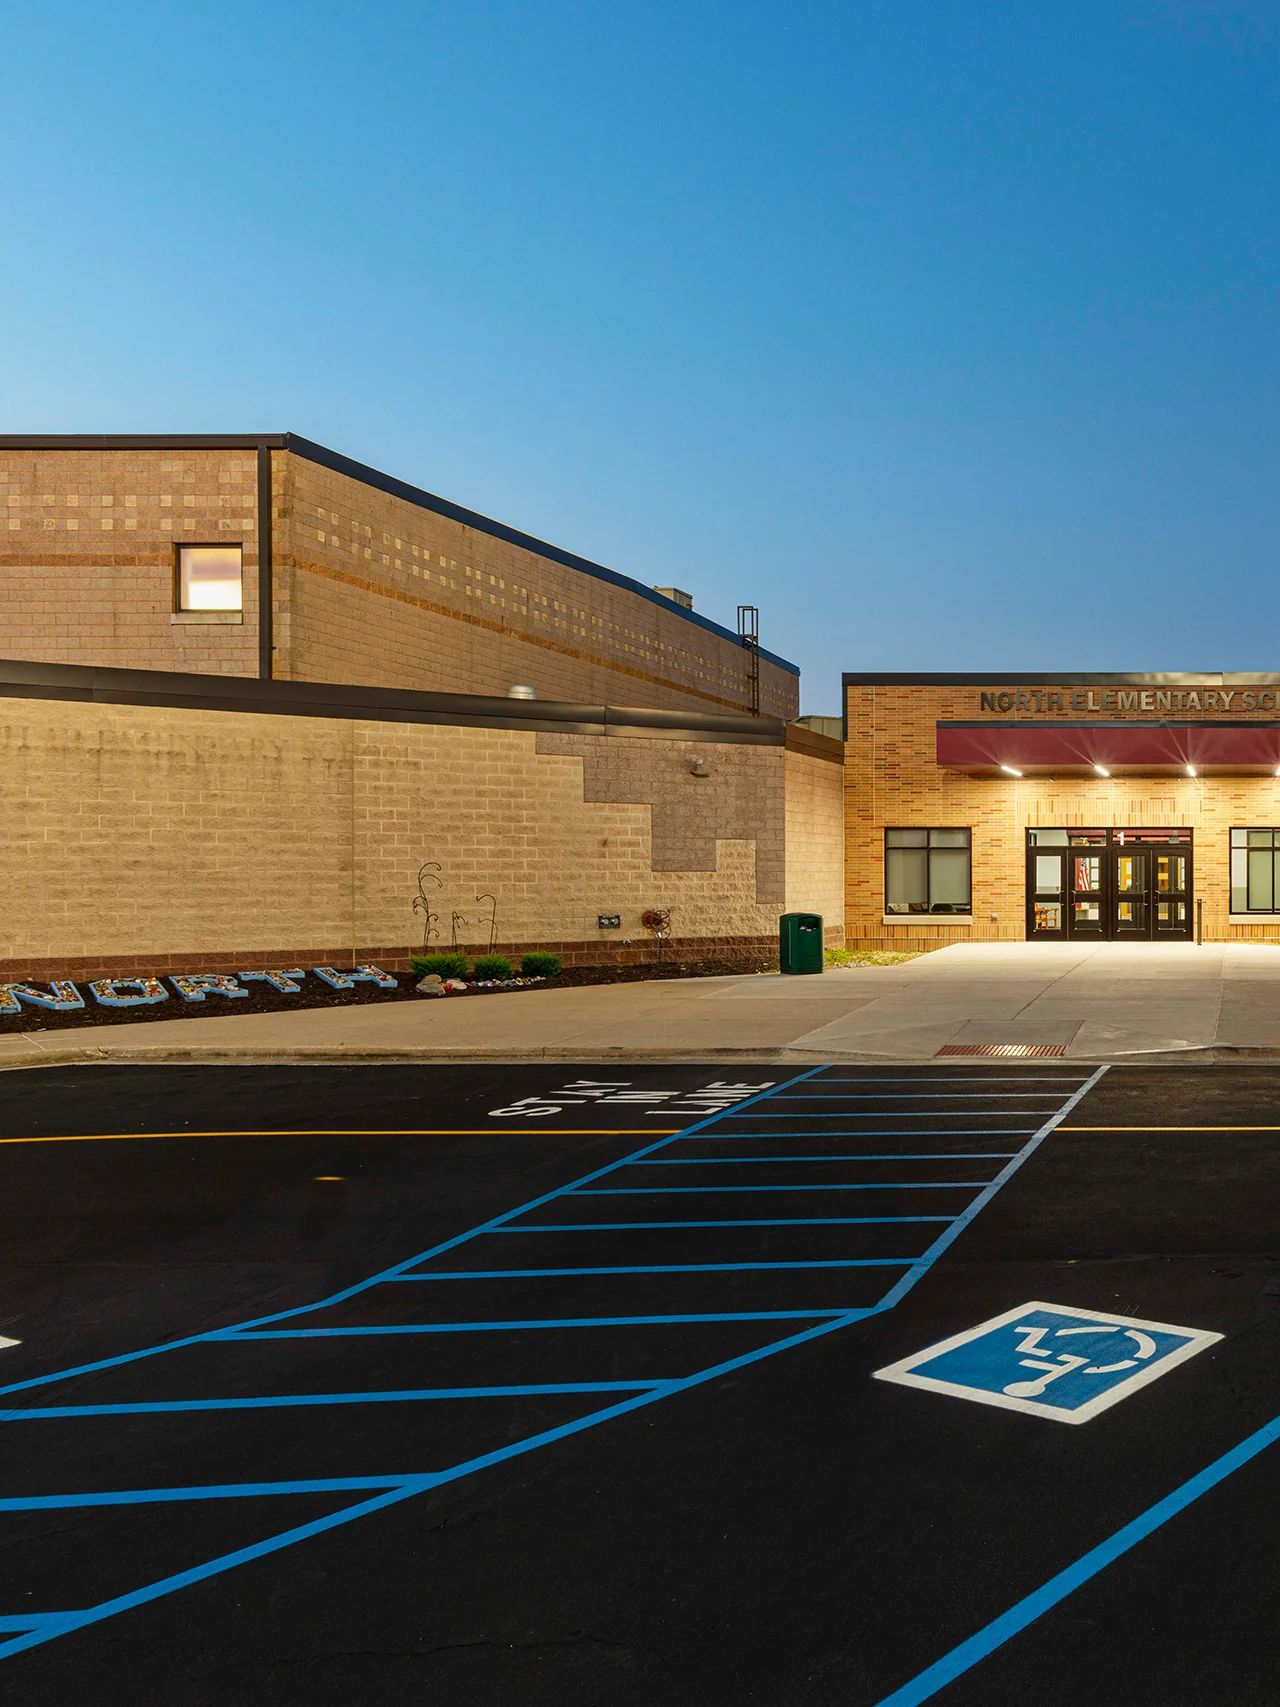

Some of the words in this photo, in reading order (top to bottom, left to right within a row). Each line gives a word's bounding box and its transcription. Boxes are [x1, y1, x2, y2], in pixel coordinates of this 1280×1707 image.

[980, 691, 1063, 712] NORTH
[1071, 691, 1235, 711] ELEMENTARY
[1116, 831, 1125, 846] 1
[0, 964, 398, 1014] NORTH
[488, 1080, 633, 1117] STAY
[594, 1090, 683, 1104] IN
[644, 1081, 776, 1115] LANE
